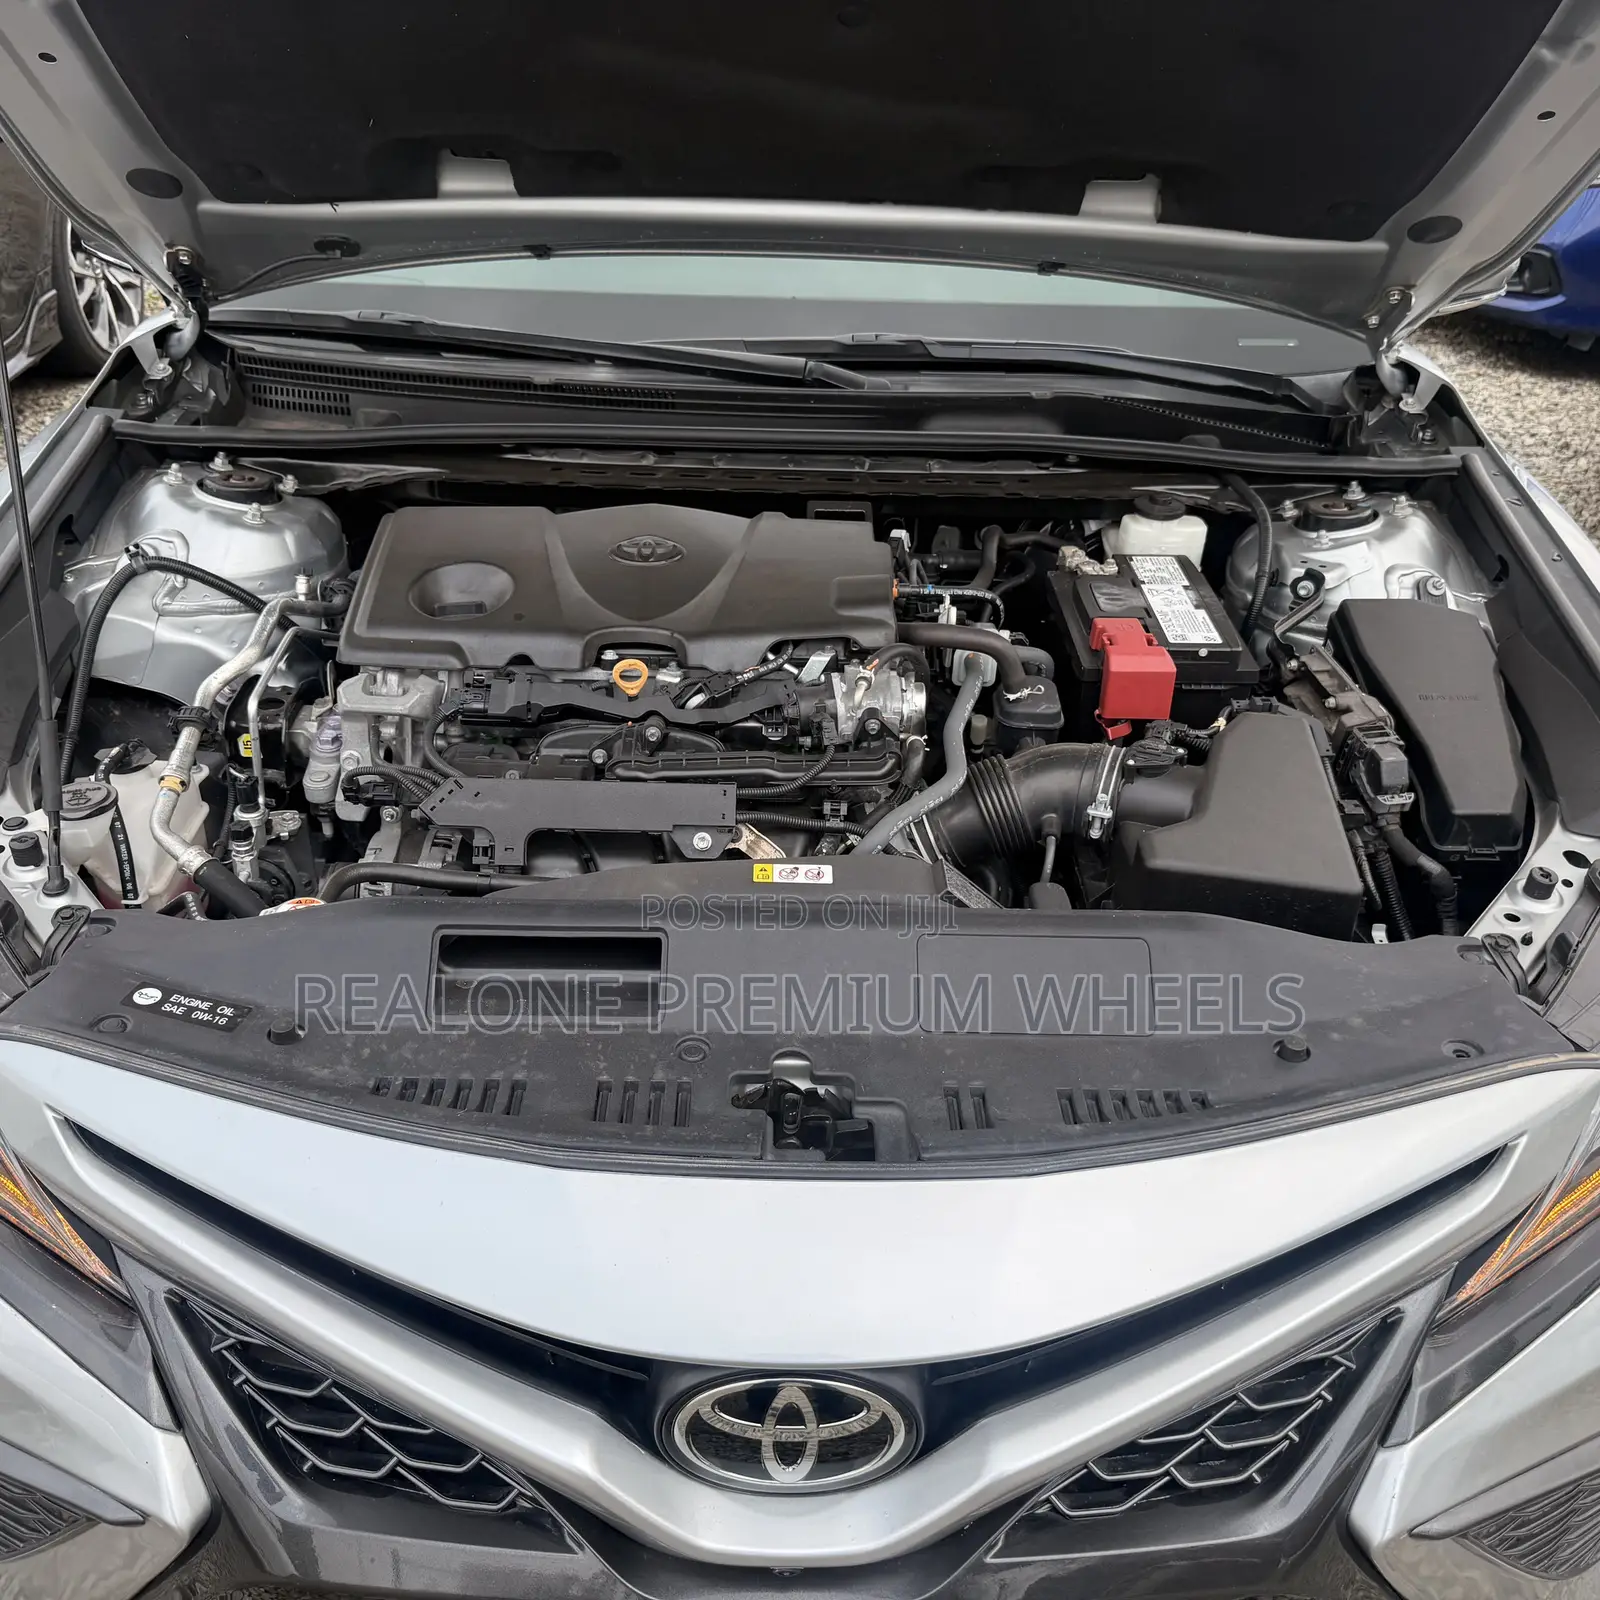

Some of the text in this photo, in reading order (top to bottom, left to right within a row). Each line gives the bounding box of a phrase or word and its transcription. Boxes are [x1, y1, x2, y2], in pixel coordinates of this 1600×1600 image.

[161, 1003, 229, 1025] SAE 0W-16
[169, 994, 236, 1016] ENGINE OIL
